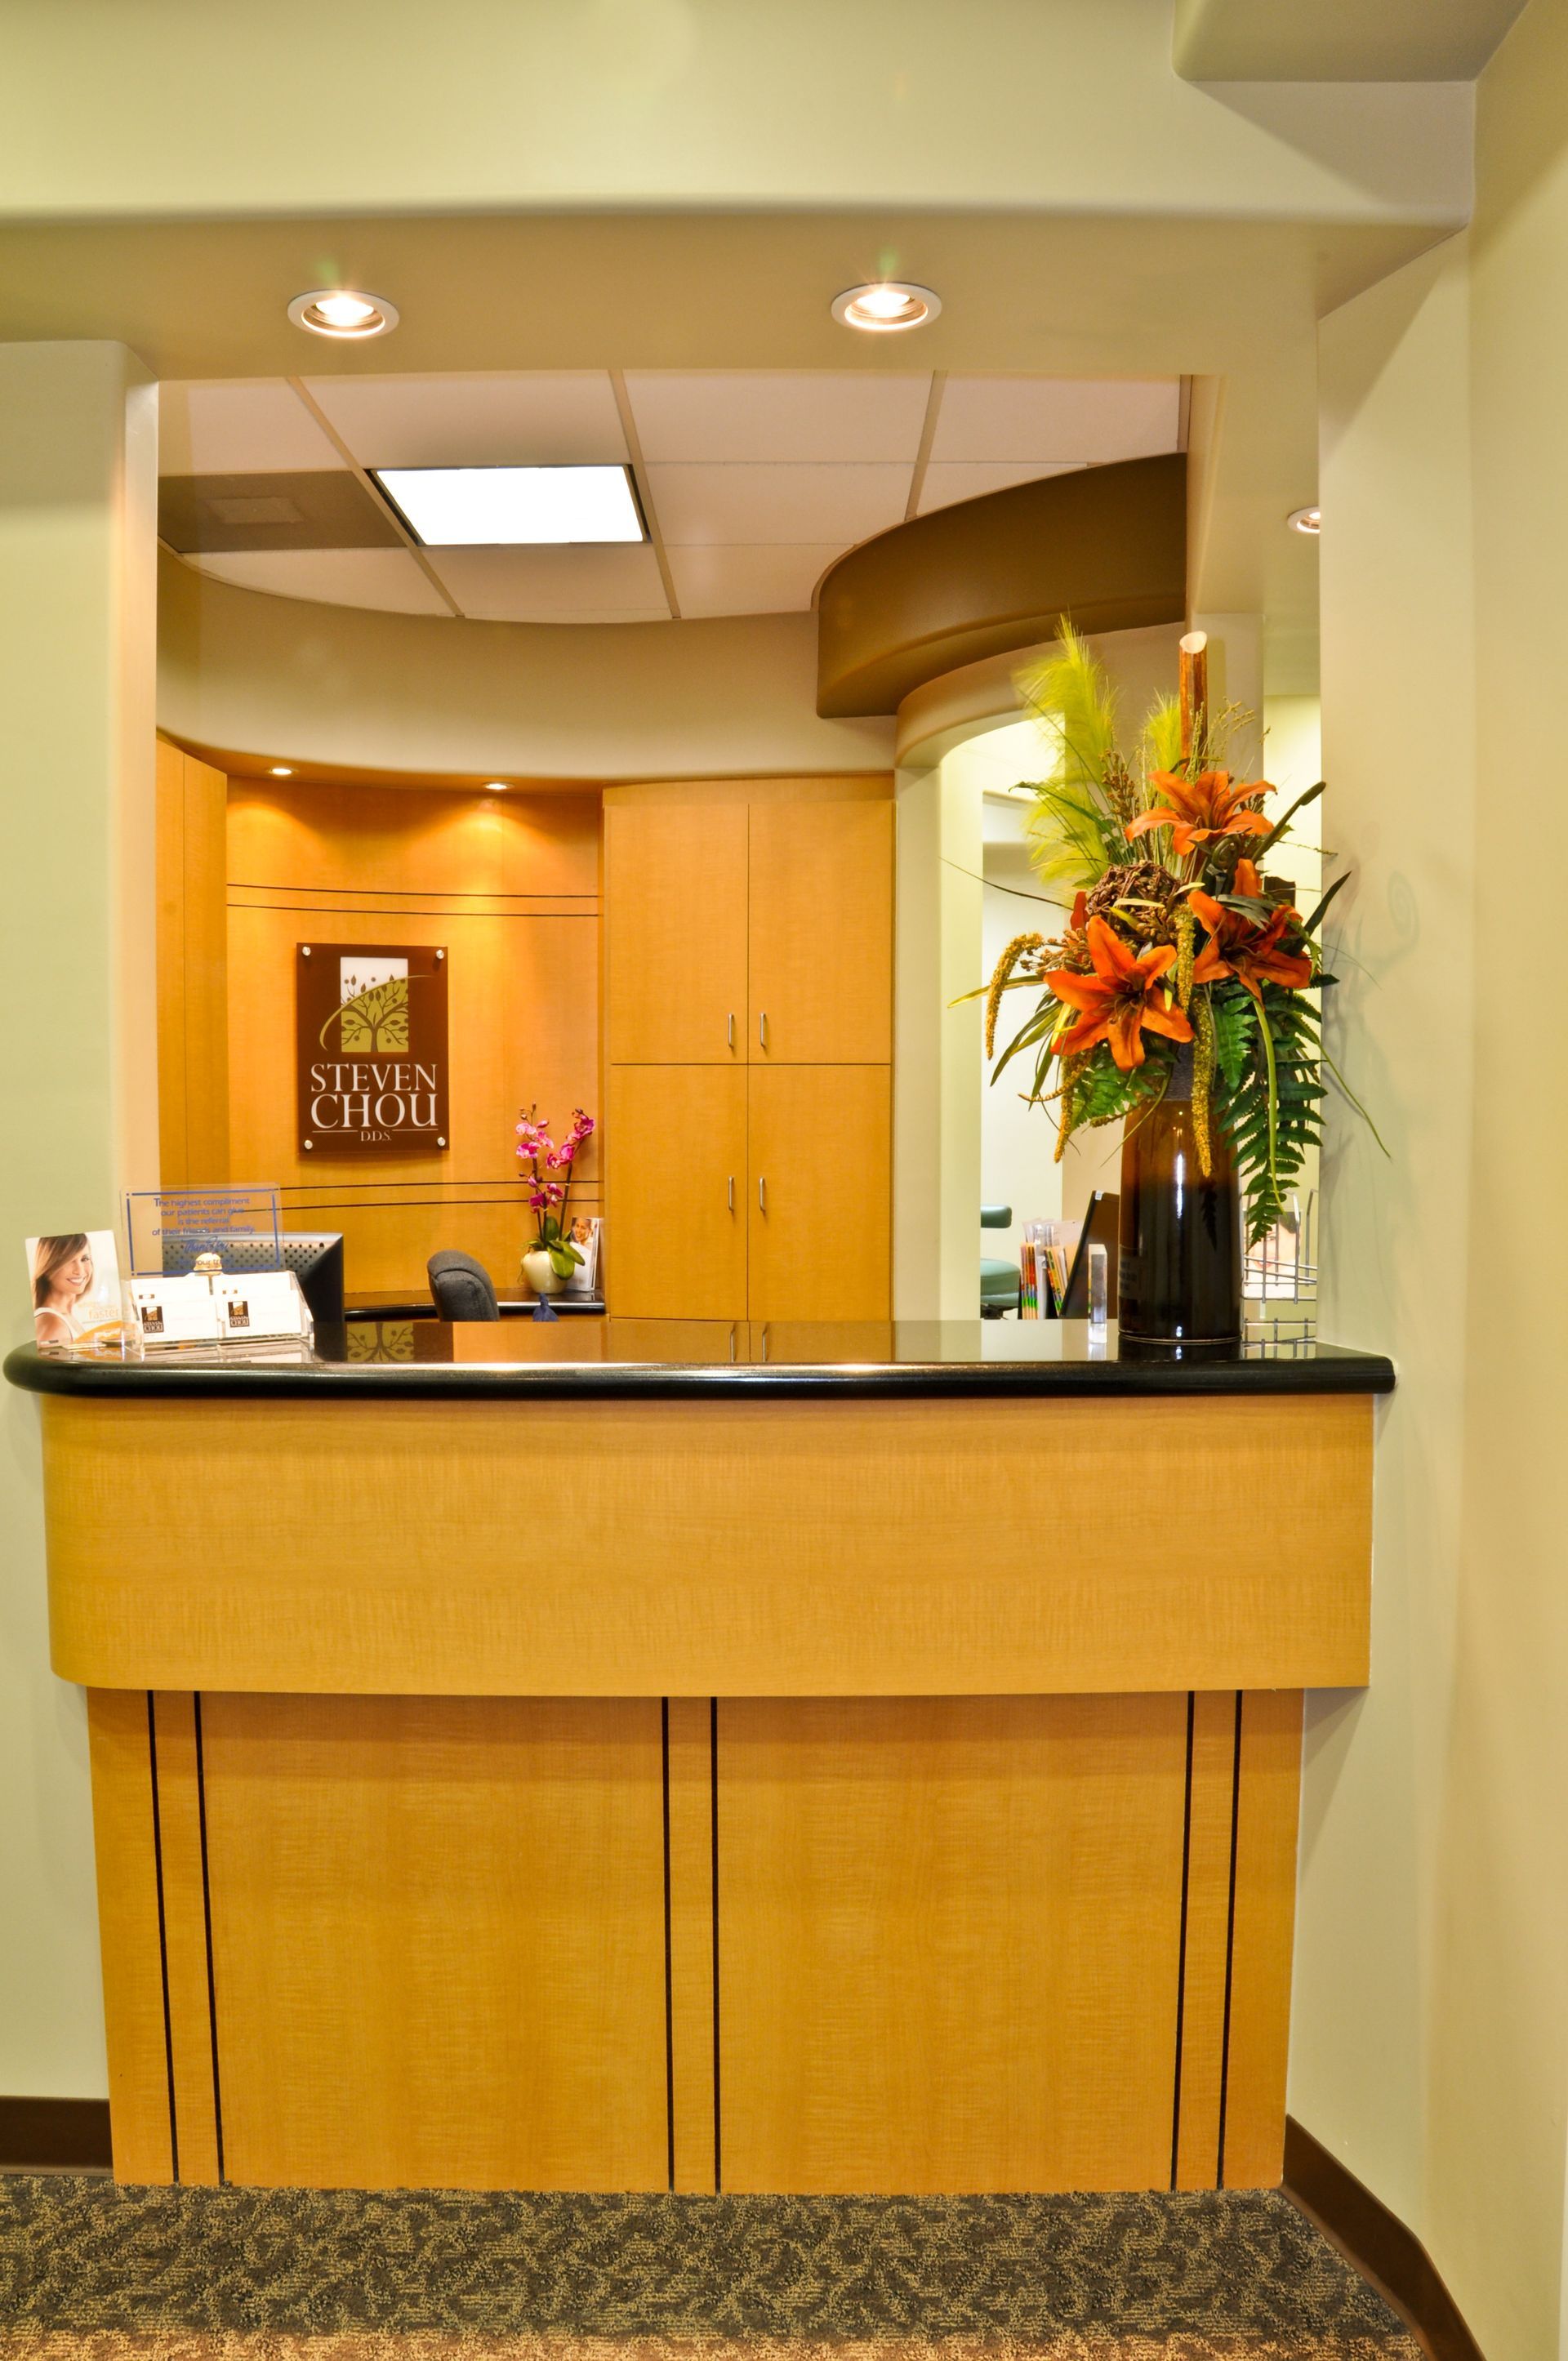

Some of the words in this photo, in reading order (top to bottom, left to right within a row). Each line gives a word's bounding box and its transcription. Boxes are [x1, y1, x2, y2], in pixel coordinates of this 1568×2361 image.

[310, 1063, 438, 1092] STEVEN
[310, 1093, 439, 1129] CHOU
[360, 1130, 392, 1142] D.D.S.
[154, 1197, 169, 1207] The
[171, 1198, 201, 1208] highest
[203, 1198, 249, 1207] compliment
[177, 1209, 209, 1217] patients
[185, 1217, 199, 1225] the
[162, 1227, 180, 1236] their
